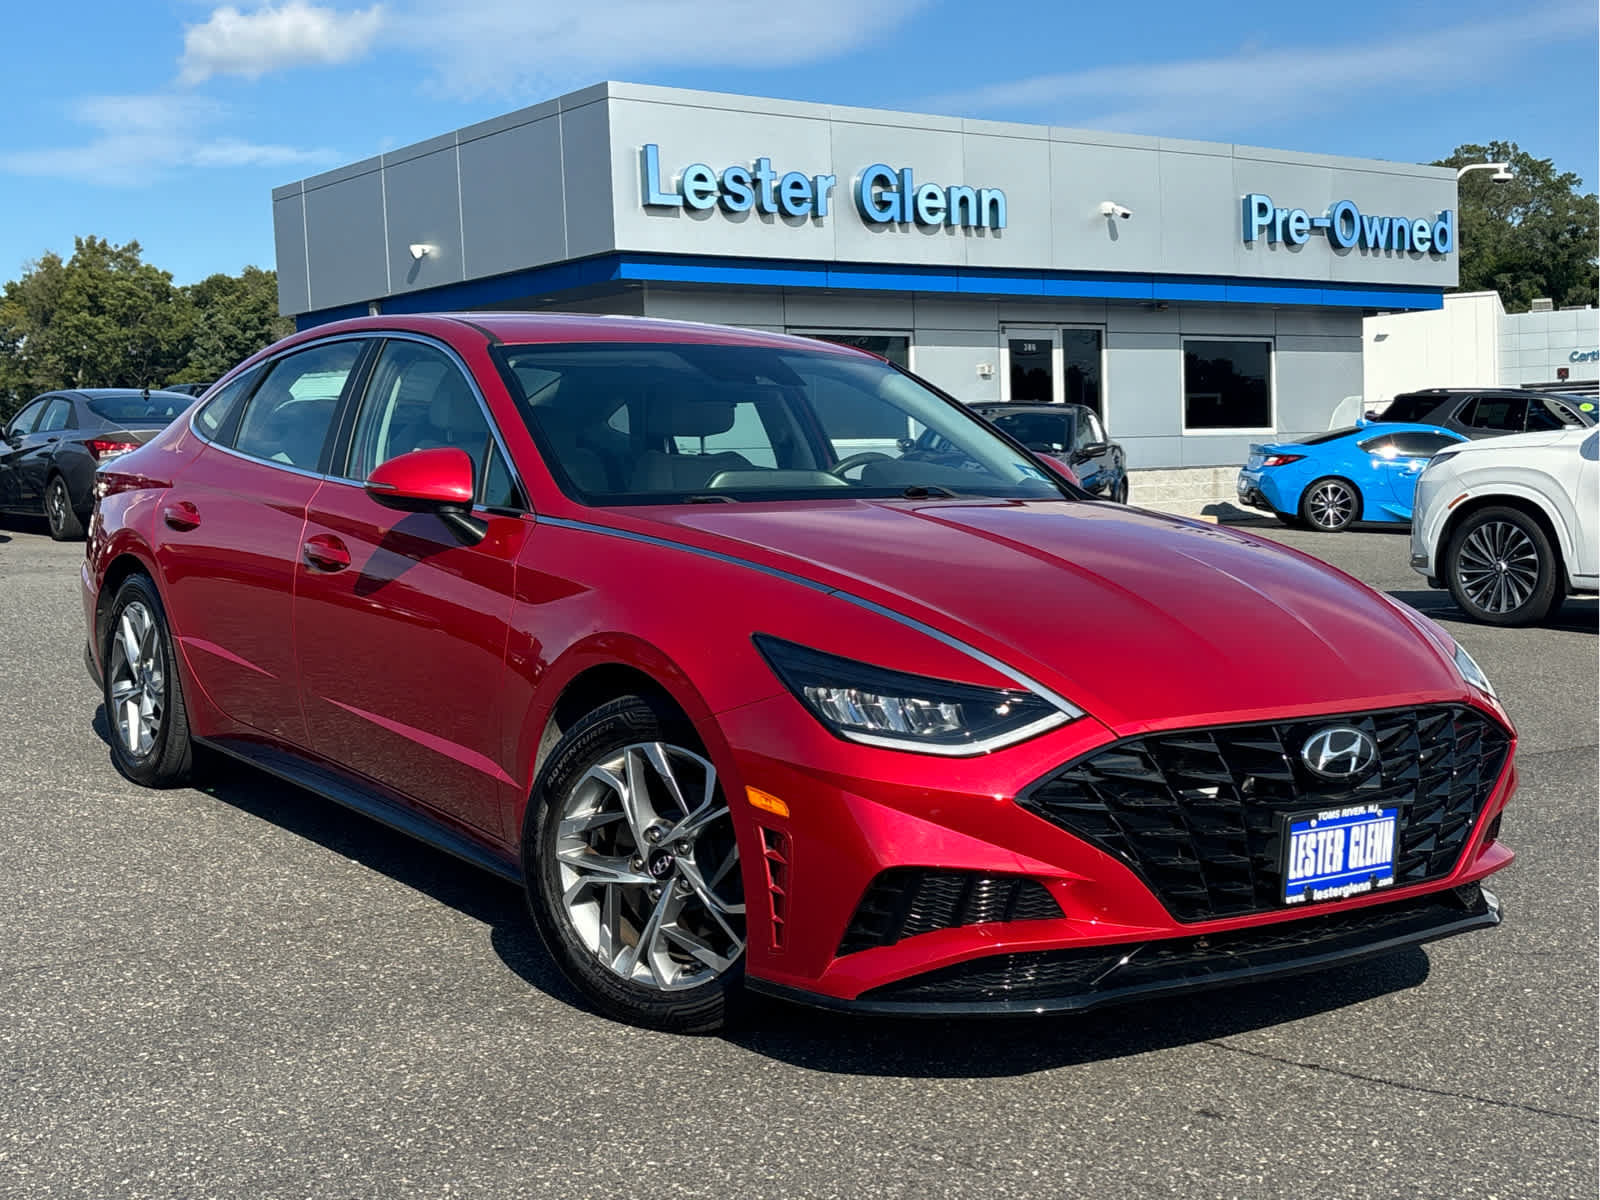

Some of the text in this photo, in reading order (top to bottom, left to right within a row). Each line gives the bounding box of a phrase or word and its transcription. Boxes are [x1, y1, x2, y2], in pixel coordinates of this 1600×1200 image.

[641, 144, 1007, 229] Lester Glenn
[1243, 194, 1454, 254] Pre-Owned
[1318, 810, 1340, 821] TOMS
[1288, 820, 1395, 880] LESTER GLENN
